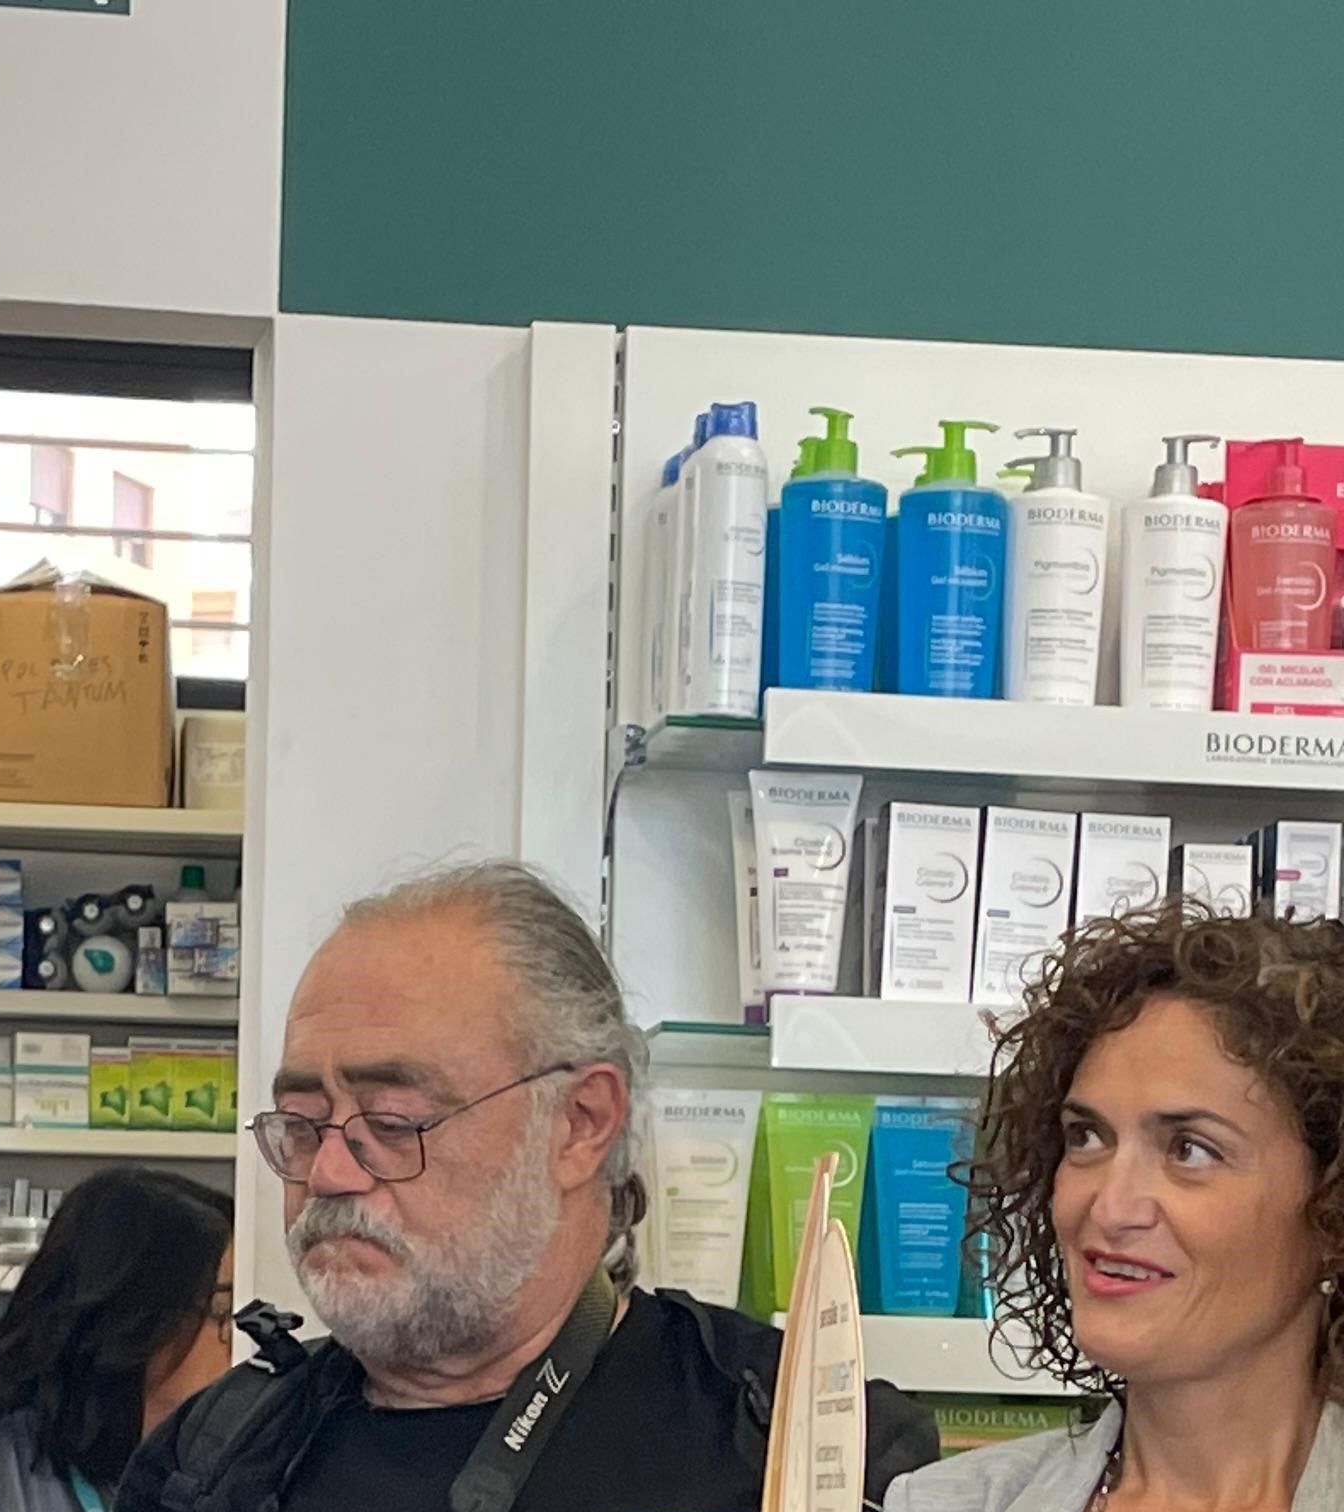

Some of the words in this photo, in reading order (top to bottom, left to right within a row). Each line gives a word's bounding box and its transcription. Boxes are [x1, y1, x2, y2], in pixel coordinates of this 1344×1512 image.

[811, 499, 882, 518] BIODERMA
[1027, 507, 1104, 525] BIODERMA
[927, 511, 1001, 531] BIODERMA
[1144, 514, 1221, 530] BIODERMA
[1251, 523, 1331, 541] BIODERMA
[768, 786, 851, 802] BIODERMA
[896, 811, 973, 828] BIODERMA
[993, 816, 1069, 834] BIODERMA
[1087, 822, 1163, 838] BIODERMA
[663, 1105, 746, 1121] BIODERMA
[776, 1108, 863, 1124] BIODERMA
[503, 1391, 549, 1452] Nikon
[934, 1407, 1049, 1428] BIODERMA
